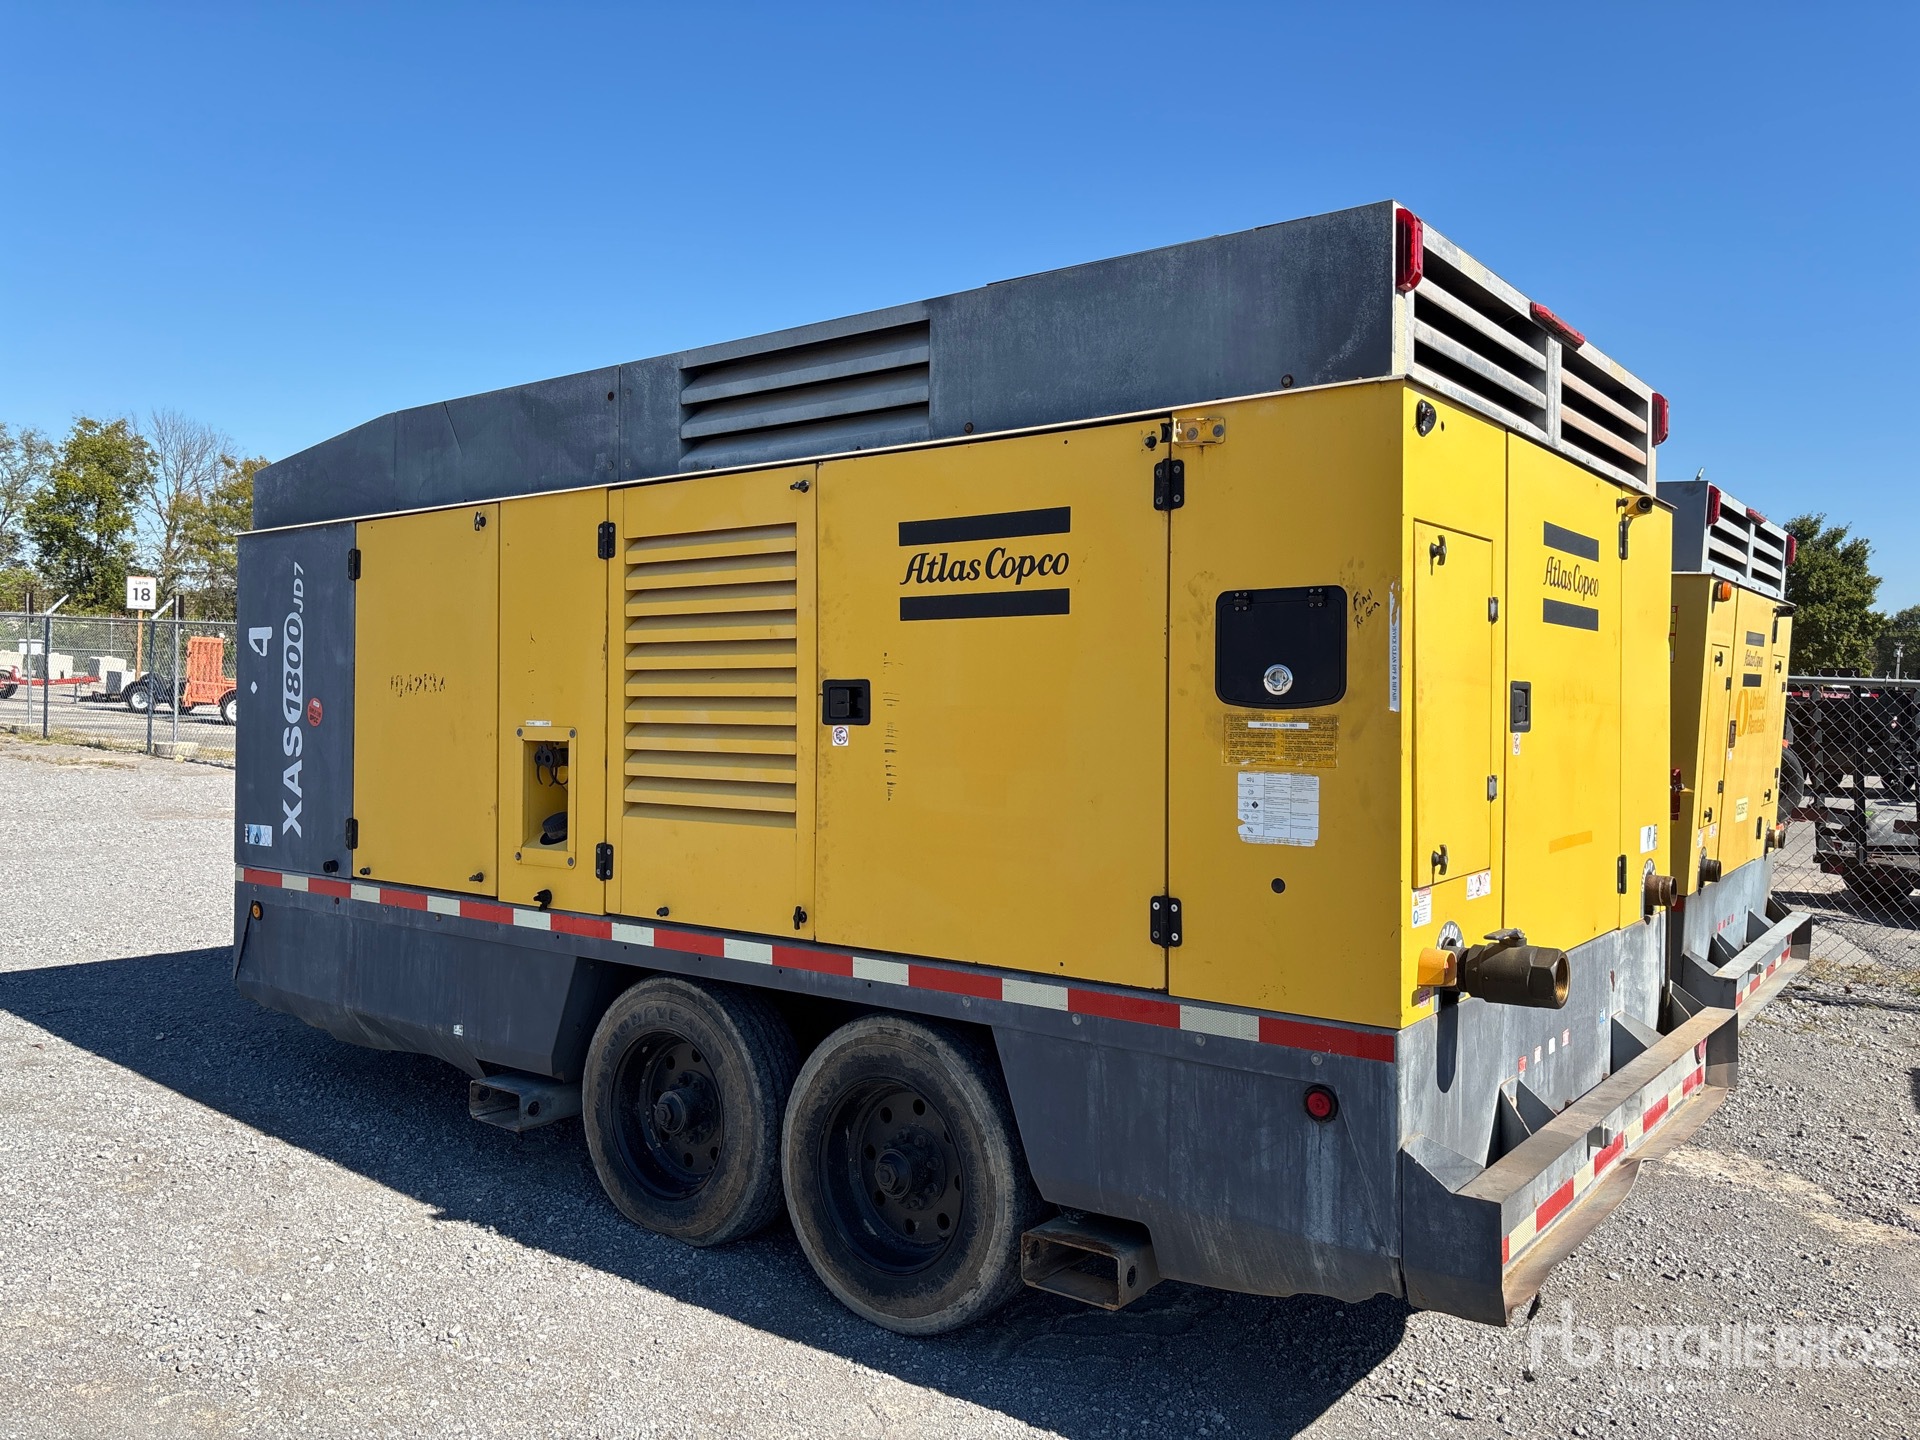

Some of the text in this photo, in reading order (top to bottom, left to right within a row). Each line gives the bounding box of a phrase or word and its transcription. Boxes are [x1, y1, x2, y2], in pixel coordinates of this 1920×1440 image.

[899, 547, 1070, 586] Atlas Copco
[1543, 556, 1599, 601] Atlas Copco
[133, 587, 151, 602] 18
